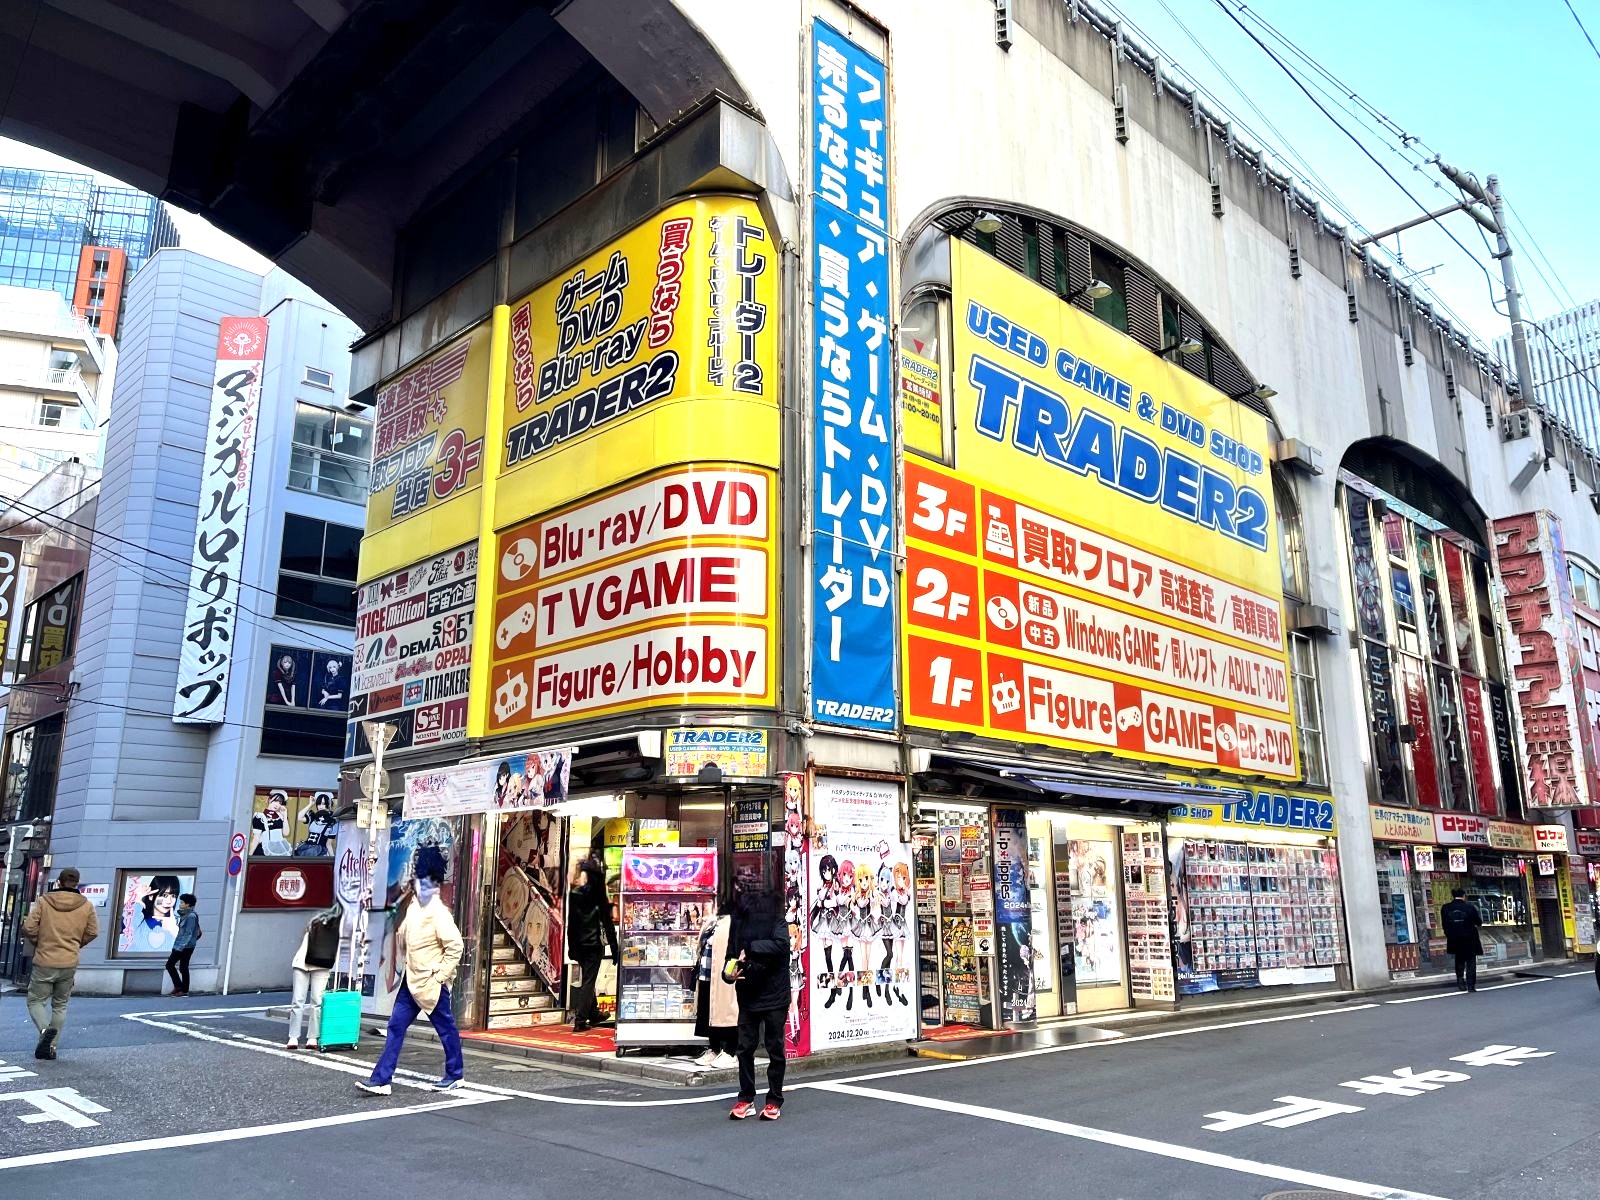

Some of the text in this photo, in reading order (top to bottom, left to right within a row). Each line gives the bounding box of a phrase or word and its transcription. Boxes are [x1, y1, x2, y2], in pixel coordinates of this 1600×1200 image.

[556, 250, 629, 321] ゲーム
[649, 217, 693, 349] 買うなら
[733, 215, 765, 395] トレーダー2
[557, 288, 625, 356] DVD
[854, 64, 890, 608] フィギュア・ゲーム・DVD
[817, 39, 853, 663] 売るなら・買うならトレーダー
[506, 351, 679, 466] TRADER2
[966, 299, 1264, 476] USED GAME & DVD SHOP
[434, 428, 483, 500] 3F
[969, 353, 1269, 551] TRADER2
[391, 468, 432, 520] 当店
[912, 481, 967, 537] 3F
[1021, 517, 1153, 599] 買取フロア
[428, 579, 477, 614] 宇宙企画
[912, 567, 970, 622] 2F
[1027, 593, 1054, 619] 新品
[1029, 624, 1056, 647] 中古
[1063, 605, 1122, 662] Windows
[423, 667, 471, 702] ATTACKERS
[535, 635, 757, 710] Figure/Hobby
[929, 656, 973, 708] 1F
[672, 730, 763, 744] TRADER2
[816, 699, 894, 723] TRADER2
[1027, 676, 1114, 736] Figure
[1146, 702, 1214, 752] GAME
[1190, 807, 1213, 820] SHOP
[1221, 788, 1334, 832] TRADER2
[1442, 816, 1484, 832] ロケット
[233, 838, 243, 850] 20
[1200, 1044, 1557, 1132] 止まれ
